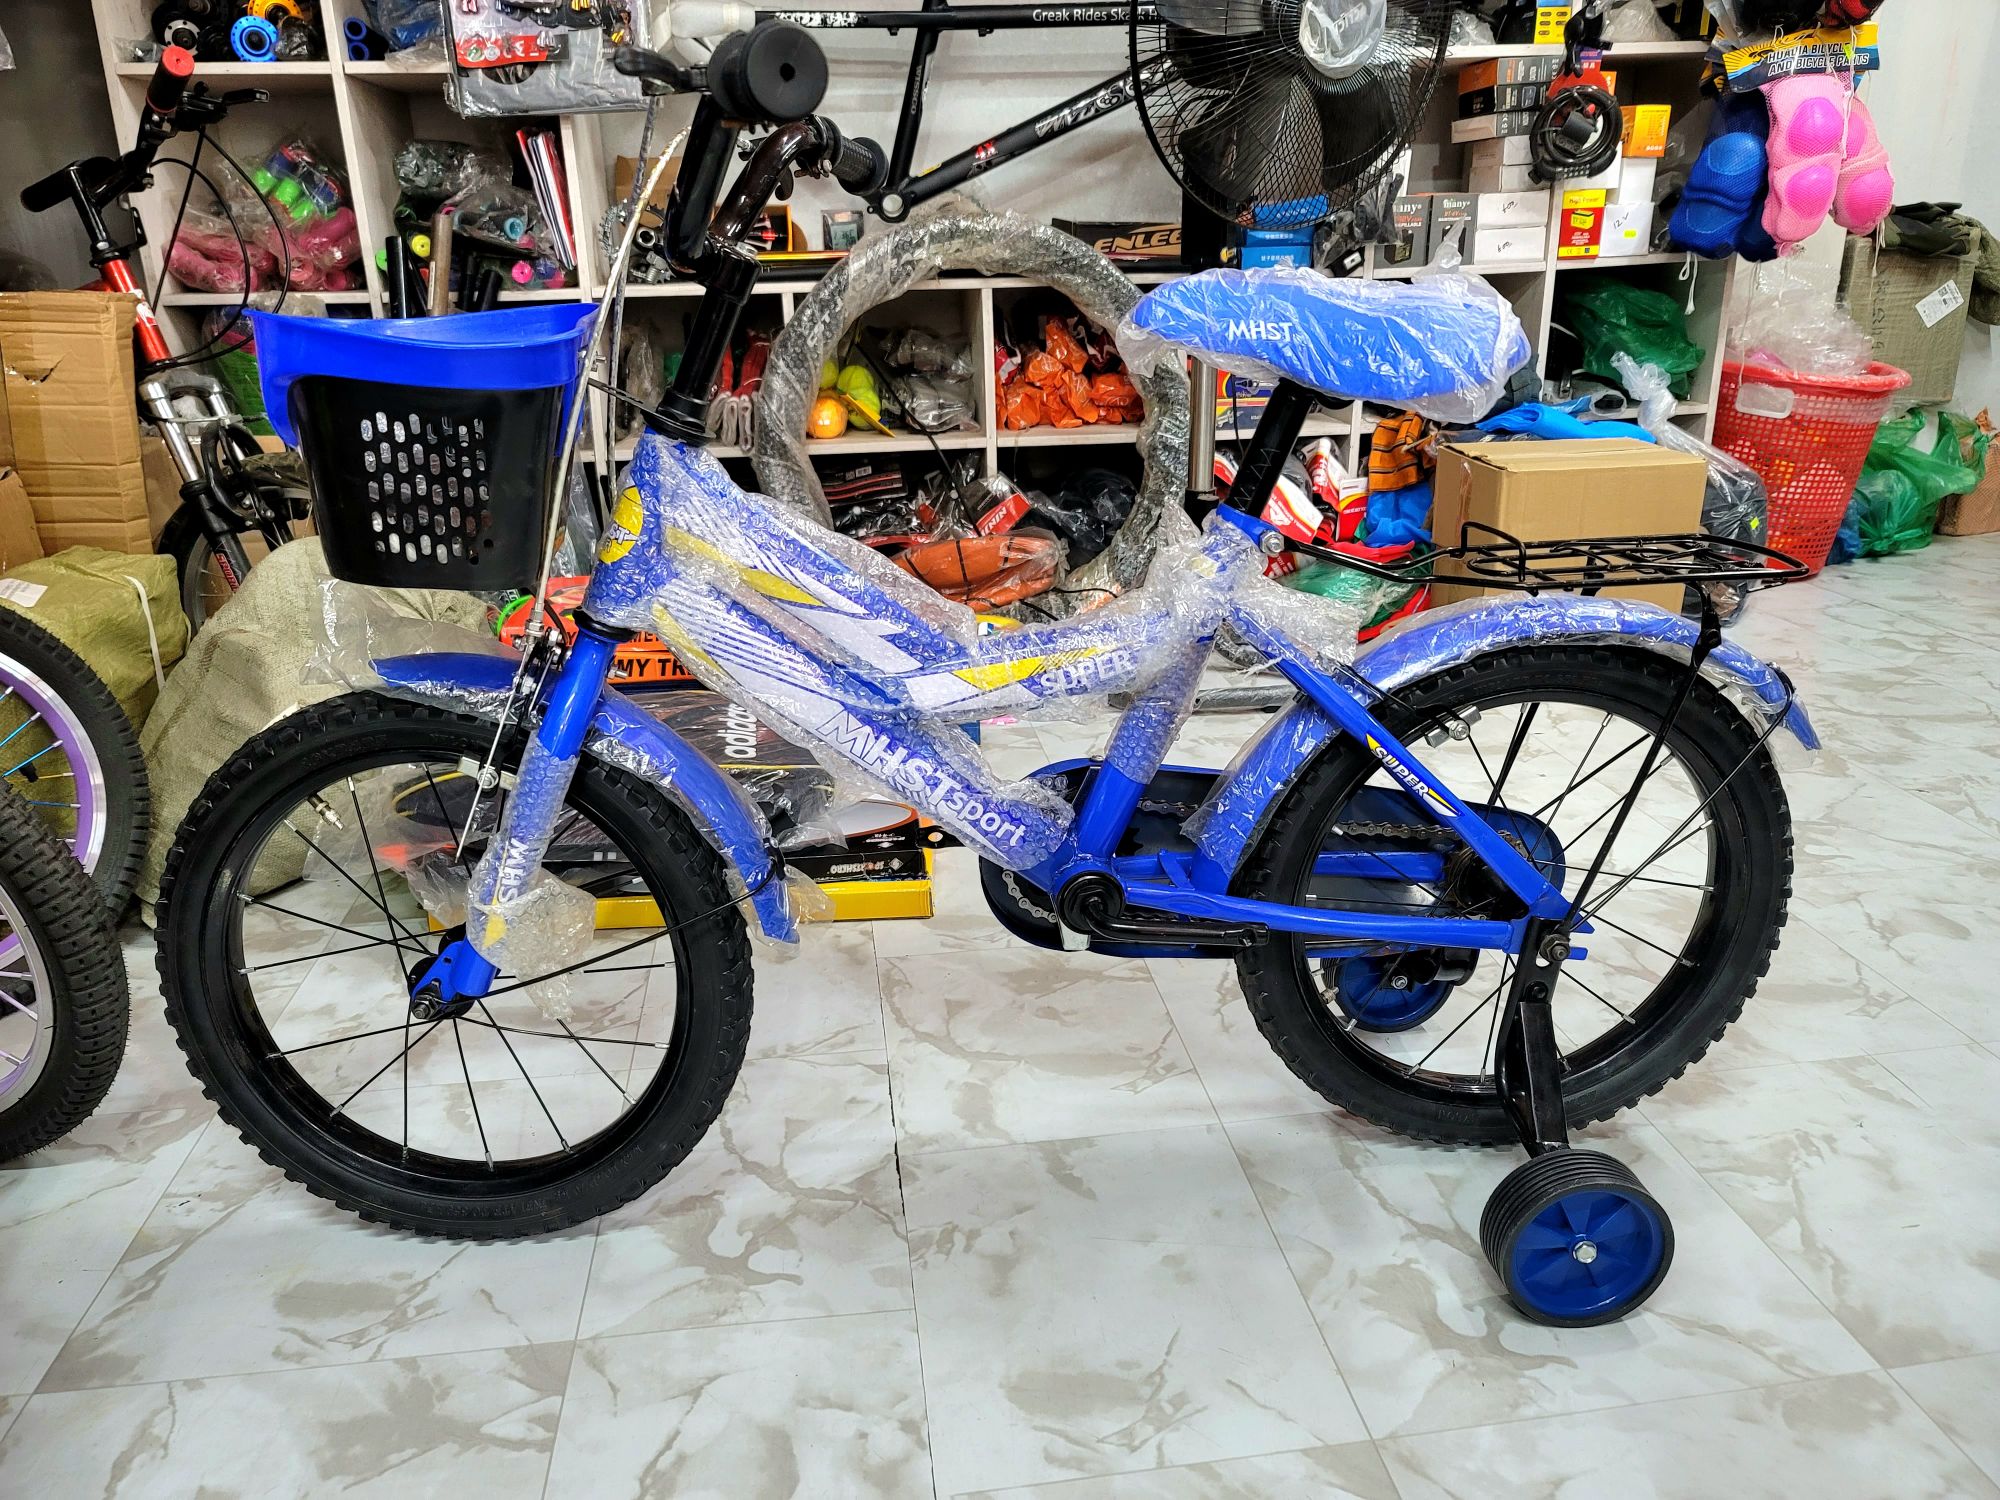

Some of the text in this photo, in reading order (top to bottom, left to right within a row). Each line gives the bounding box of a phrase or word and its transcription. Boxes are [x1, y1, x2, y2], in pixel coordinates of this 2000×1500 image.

[1073, 8, 1107, 21] Rides
[1768, 60, 1793, 76] AND
[1229, 319, 1293, 342] MHST
[1041, 646, 1134, 695] SUPER
[1375, 747, 1430, 798] SUPER
[498, 838, 531, 903] MHS
